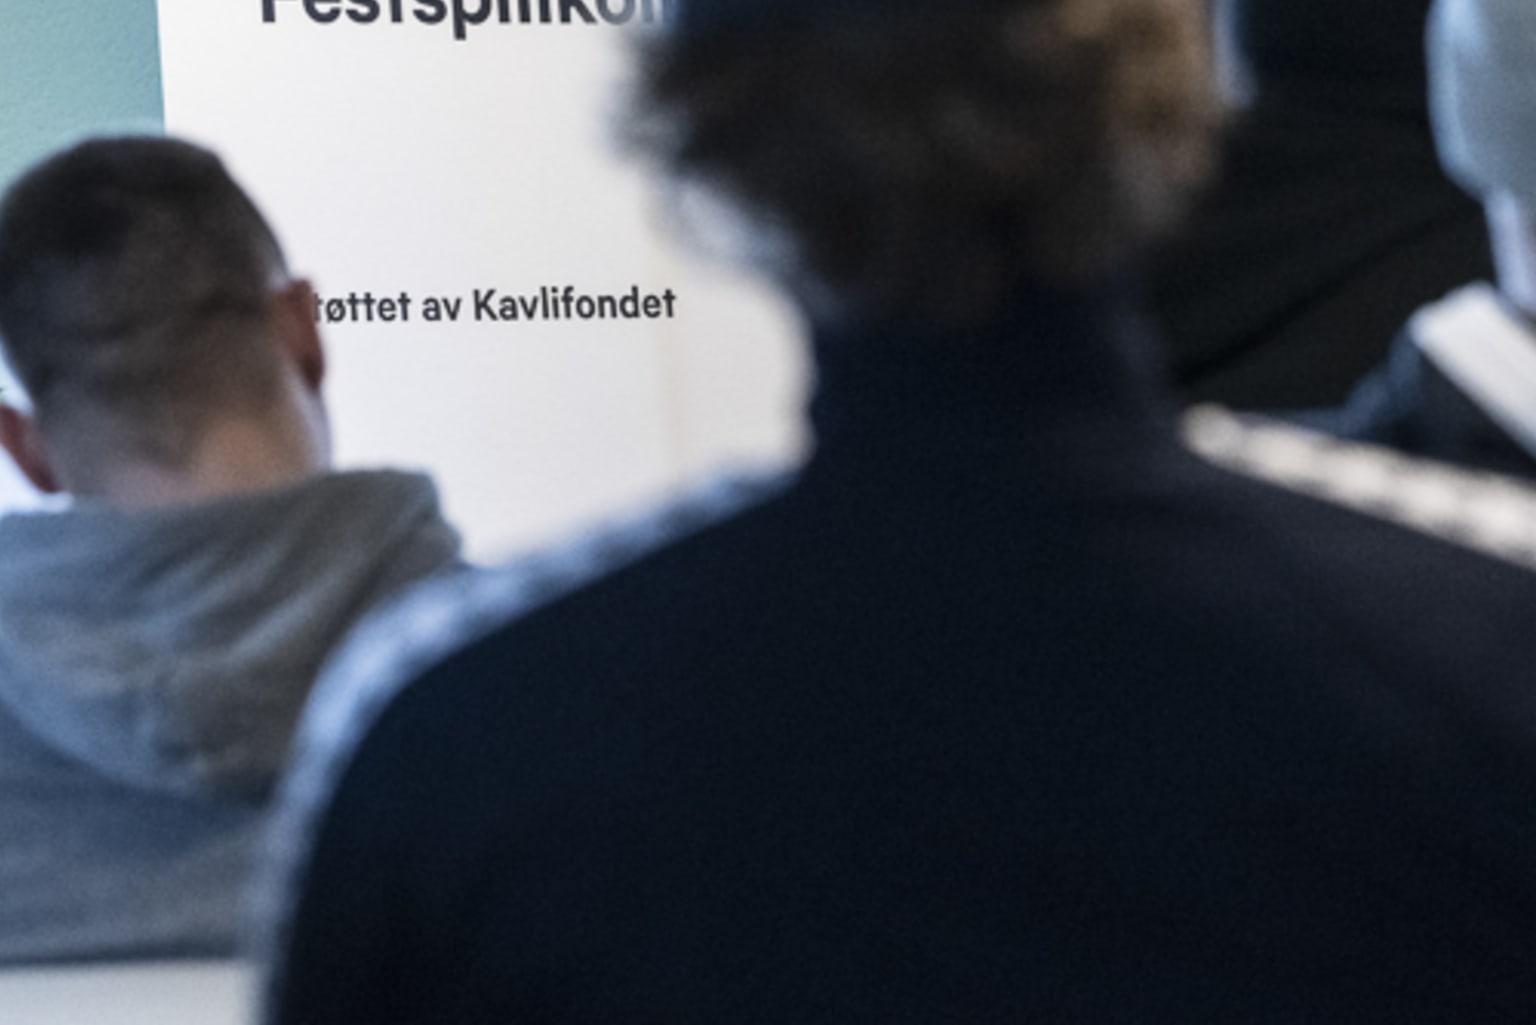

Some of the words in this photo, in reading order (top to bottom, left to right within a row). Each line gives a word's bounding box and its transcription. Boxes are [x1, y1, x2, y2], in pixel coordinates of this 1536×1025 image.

[314, 291, 412, 323] tøttet
[422, 297, 462, 322] av
[473, 285, 677, 322] Kavlifondet
